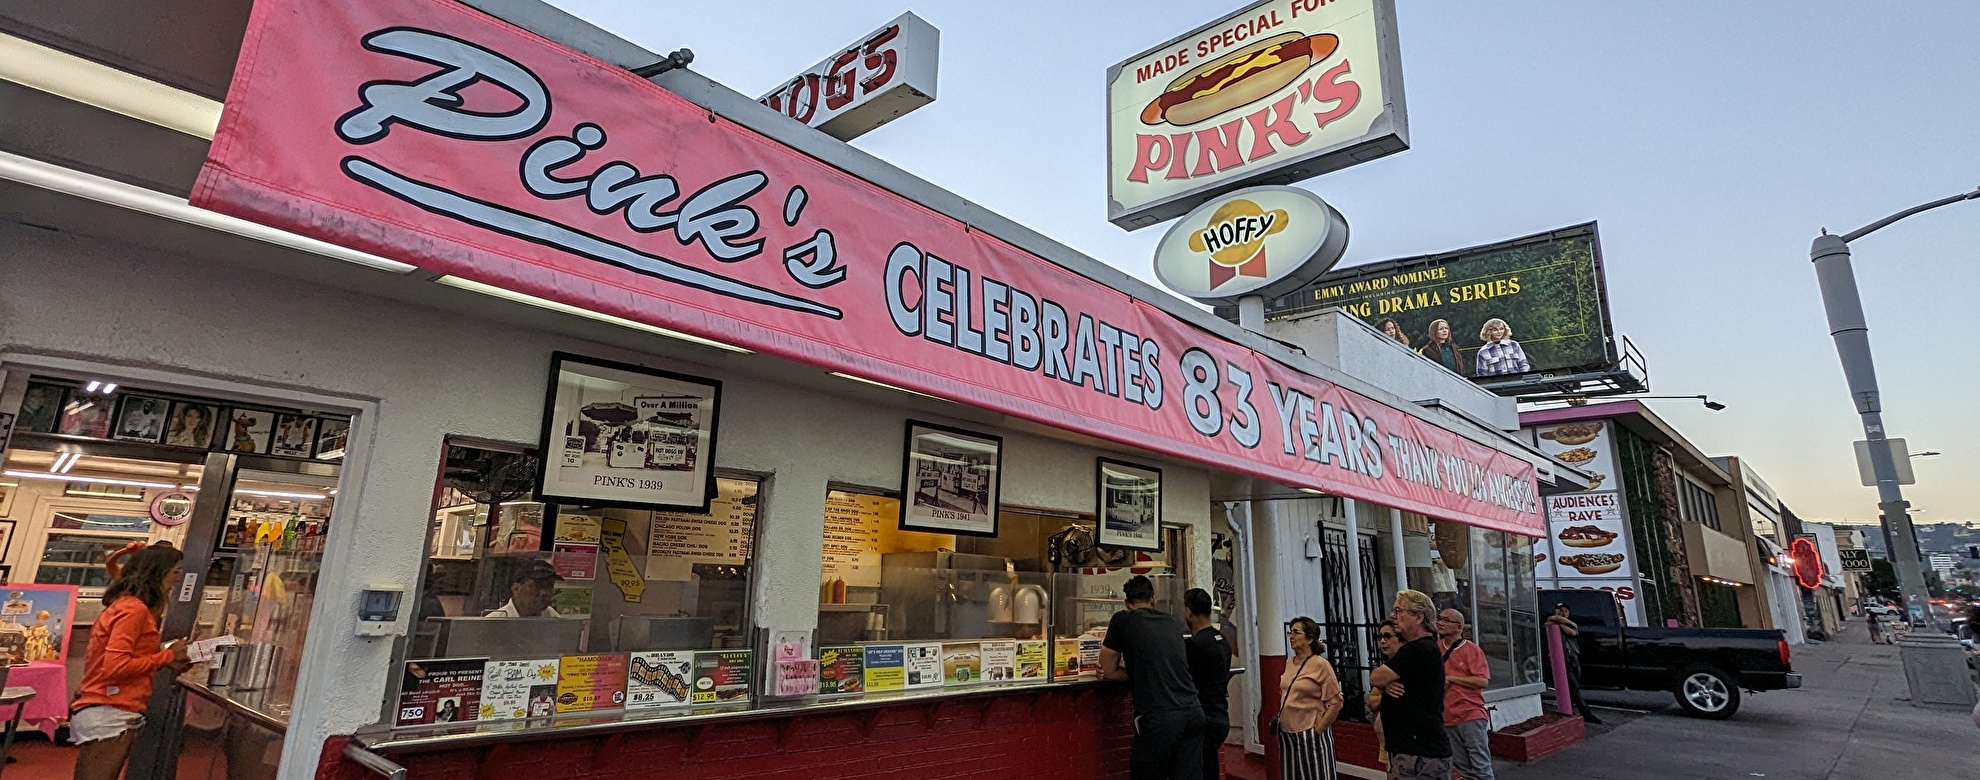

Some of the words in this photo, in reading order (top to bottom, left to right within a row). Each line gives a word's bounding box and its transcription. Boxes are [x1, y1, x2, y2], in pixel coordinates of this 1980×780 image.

[1136, 48, 1190, 84] MADE
[1196, 10, 1284, 58] SPECIAL
[1127, 59, 1362, 183] PINK'S
[335, 26, 847, 289] Pink's
[1203, 214, 1274, 252] HOFFY
[1314, 285, 1345, 300] EMMY
[1349, 278, 1388, 294] AWARD
[1393, 267, 1446, 284] NOMINEE
[1362, 290, 1396, 299] INCLUDING
[1379, 290, 1442, 315] DRAMA
[1450, 277, 1520, 303] SERIES
[883, 241, 1163, 411] CELEBRATES
[1180, 347, 1261, 449] 83
[1266, 380, 1383, 480] YEARS
[1388, 432, 1442, 489] THANK
[1442, 450, 1469, 497] YOU
[1468, 460, 1487, 502] LOS
[641, 401, 658, 409] Over
[668, 401, 698, 409] Million
[594, 475, 635, 489] PINK'S
[638, 479, 663, 490] 1939
[1552, 494, 1615, 510] AUDIENCES
[932, 510, 955, 520] PINK'S
[1568, 510, 1602, 521] RAVE
[622, 580, 640, 588] $9.95
[1090, 584, 1110, 594] 1939
[402, 708, 423, 718] 750
